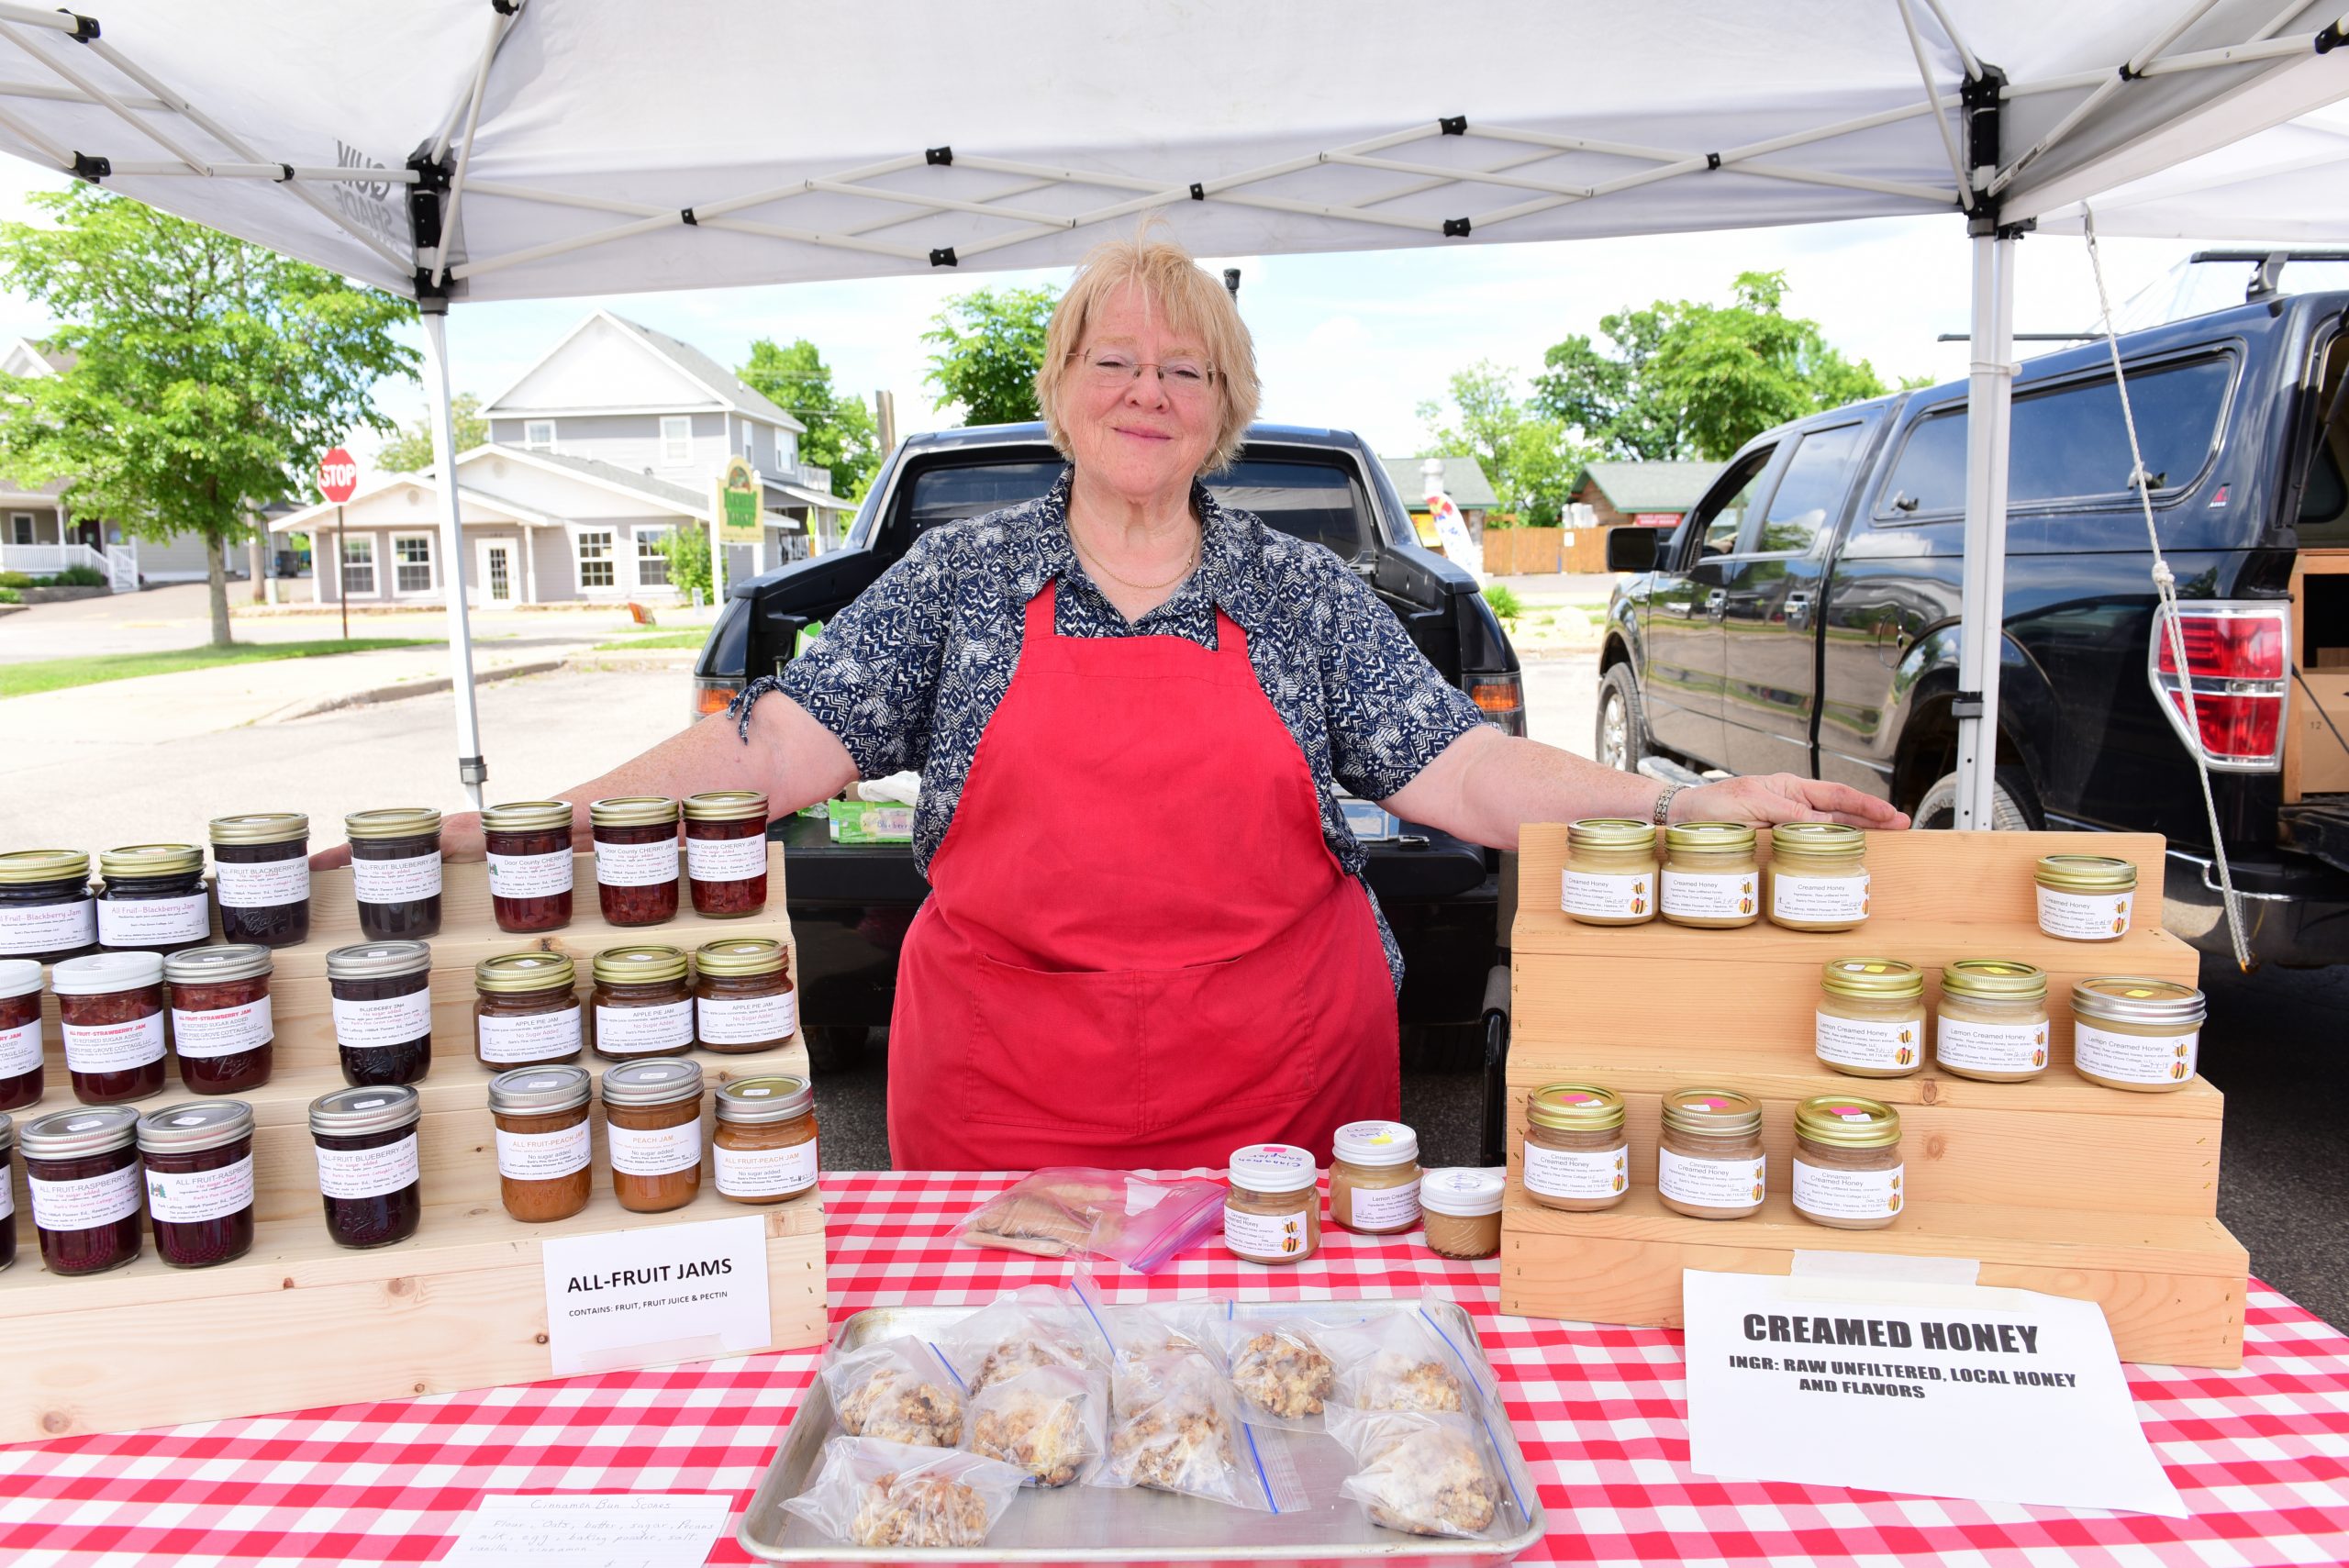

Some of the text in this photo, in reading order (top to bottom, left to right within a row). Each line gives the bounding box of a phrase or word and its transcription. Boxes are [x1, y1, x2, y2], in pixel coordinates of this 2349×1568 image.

[320, 463, 356, 488] STOP
[618, 846, 638, 854] County
[639, 844, 664, 853] CHERRY
[665, 842, 674, 851] JAM
[720, 841, 745, 850] CHERRY
[390, 860, 429, 870] BLUEBERRY
[518, 858, 540, 867] County
[541, 855, 564, 864] CHERRY
[250, 865, 295, 874] BLACKBERRY
[1568, 877, 1590, 886] Creamed
[1673, 879, 1718, 888] Creamed Honey
[2045, 896, 2090, 909] Creamed Honey
[67, 908, 82, 917] Jam
[134, 1023, 146, 1031] JAM
[642, 1021, 658, 1029] Sugar
[1820, 1020, 1888, 1038] Lemon Creamed Honey
[1951, 1028, 1971, 1037] Lemon
[1972, 1031, 2004, 1040] Creamed
[141, 1039, 152, 1047] LLC
[2087, 1035, 2108, 1045] Lemon
[2109, 1040, 2140, 1051] Creamed
[527, 1135, 573, 1148] FRUIT-PEACH
[355, 1146, 400, 1162] BLUEBERRY
[401, 1141, 411, 1151] JAM
[554, 1149, 572, 1157] added
[737, 1155, 785, 1164] FRUIT-PEACH
[1540, 1156, 1567, 1166] Creamed
[1551, 1153, 1578, 1162] Cinnamon
[1677, 1163, 1707, 1174] Creamed
[1689, 1161, 1718, 1169] Cinnamon
[51, 1174, 126, 1193] FRUIT-RASPBERRY
[127, 1167, 137, 1178] JAM
[1810, 1174, 1841, 1185] Creamed
[1821, 1172, 1852, 1180] Cinnamon
[1242, 1218, 1259, 1229] Honey
[566, 1258, 732, 1294] ALL-FRUIT JAMS
[568, 1306, 613, 1318] CONTAINS:
[615, 1302, 641, 1312] FRUIT,
[643, 1298, 666, 1308] FRUIT
[668, 1296, 689, 1305] JUICE
[700, 1291, 728, 1301] PECTIN
[1742, 1313, 2039, 1354] CREAMED HONEY
[1729, 1355, 2076, 1388] INGR: RAW UNFILTERED, LOCAL HONEY
[1798, 1378, 1926, 1399] AND FLAVORS
[530, 1496, 671, 1510] Cinnamon Bun Scones
